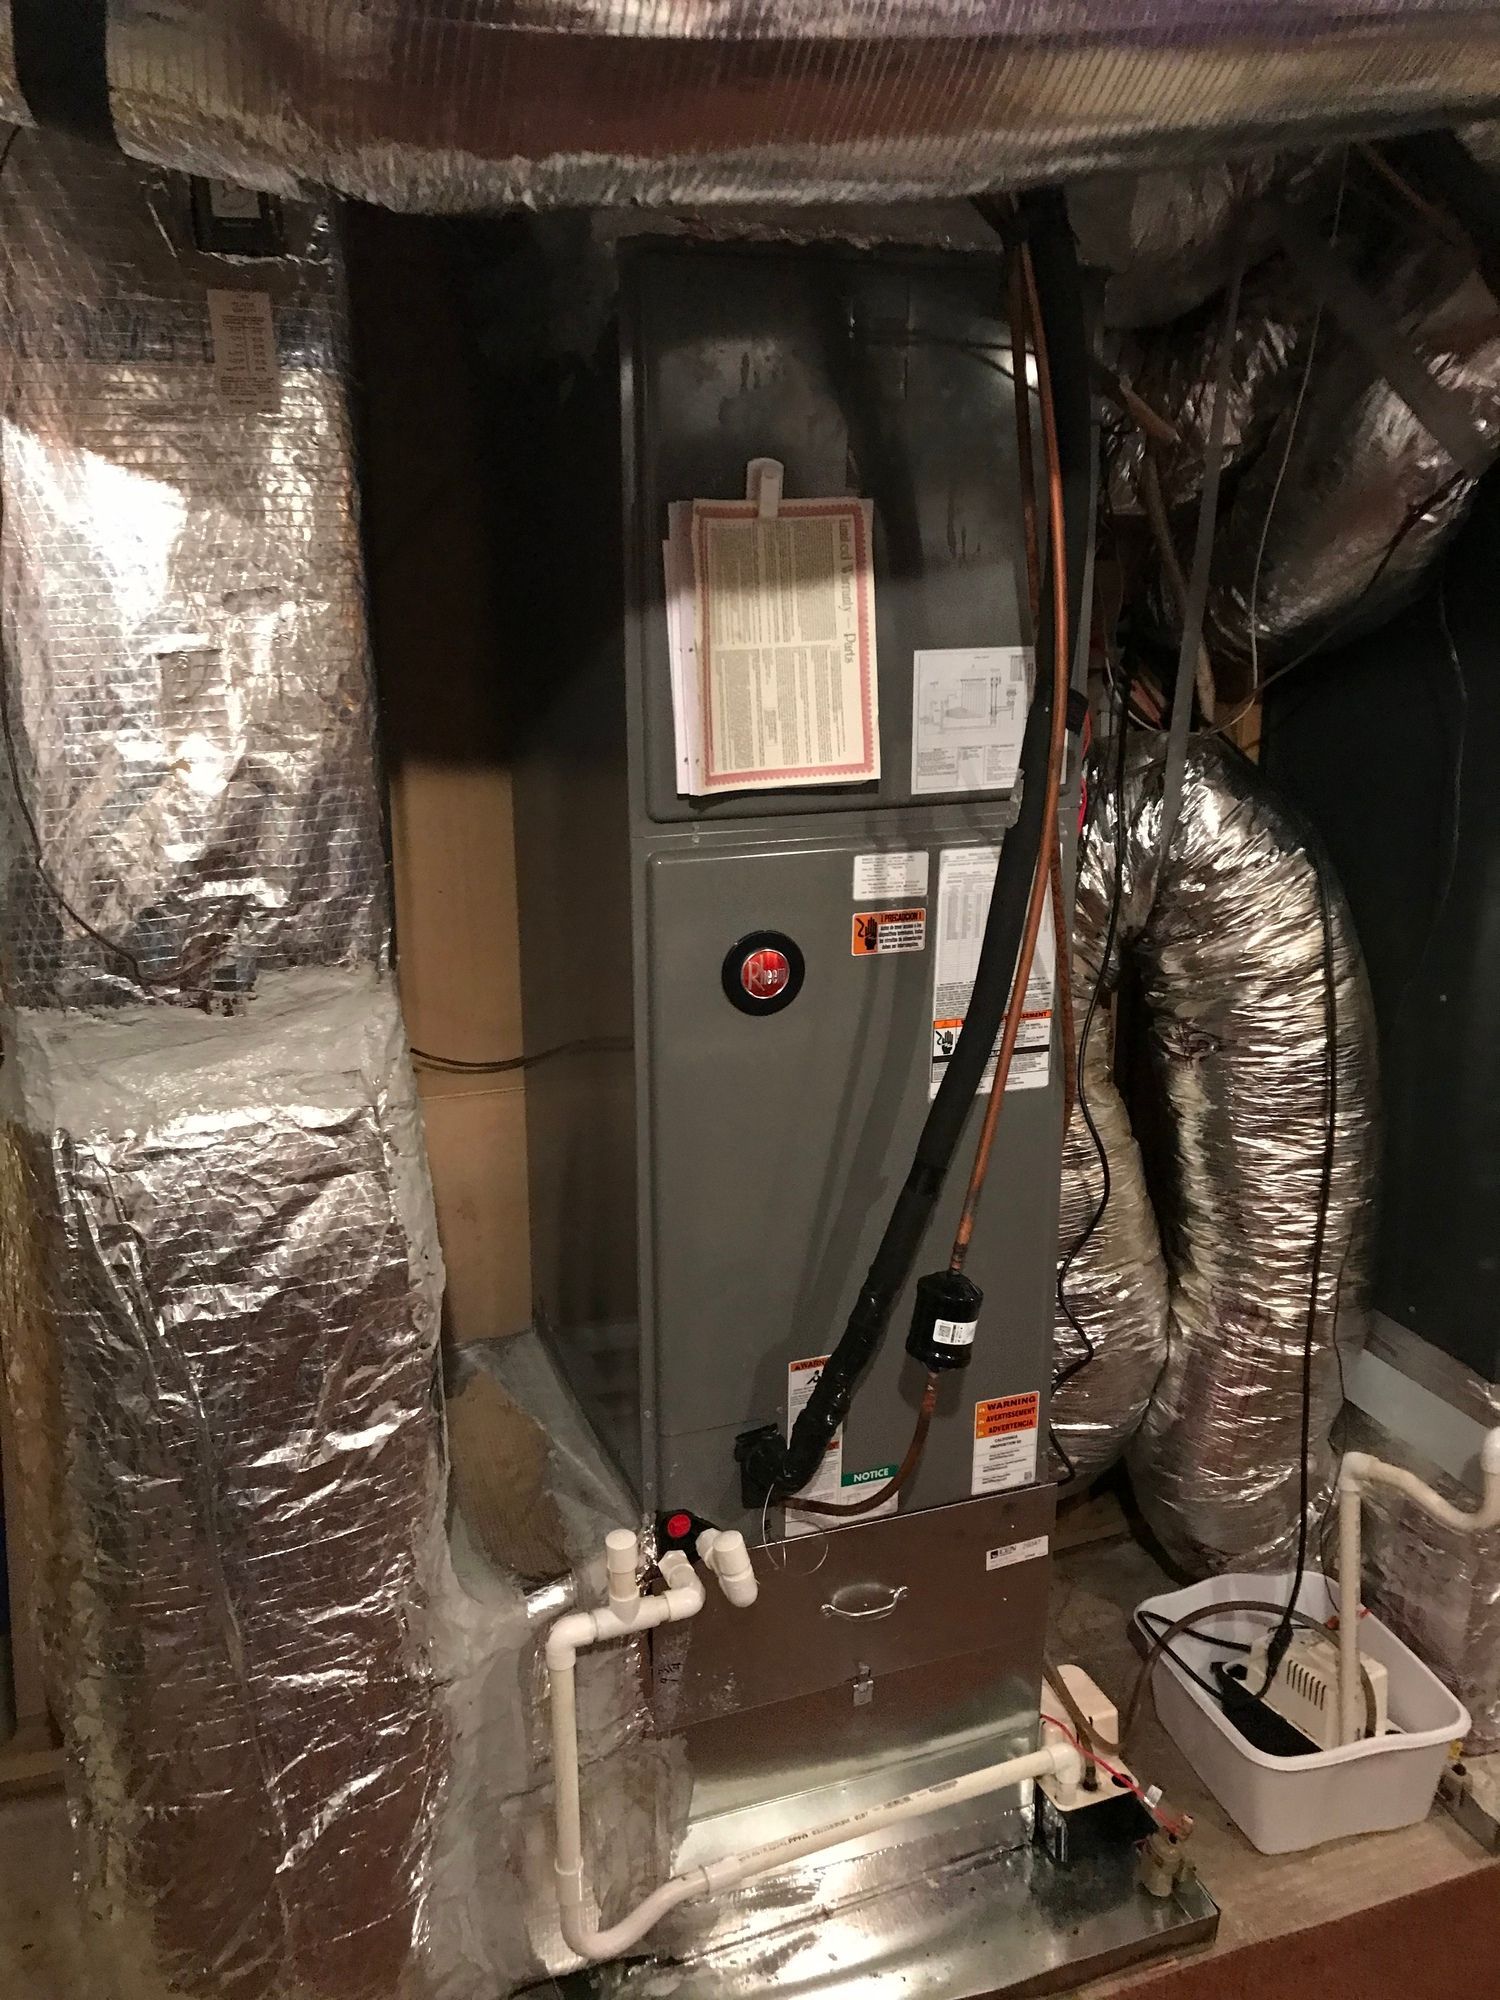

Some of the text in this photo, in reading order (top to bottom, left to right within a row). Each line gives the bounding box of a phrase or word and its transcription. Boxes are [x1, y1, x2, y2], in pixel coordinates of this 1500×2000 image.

[844, 633, 857, 664] Parts
[987, 1396, 1036, 1411] WARNING
[986, 1407, 1035, 1422] AVERTISSEMENT
[988, 1419, 1034, 1434] ADVERTENCIA
[853, 1467, 889, 1482] NOTICE
